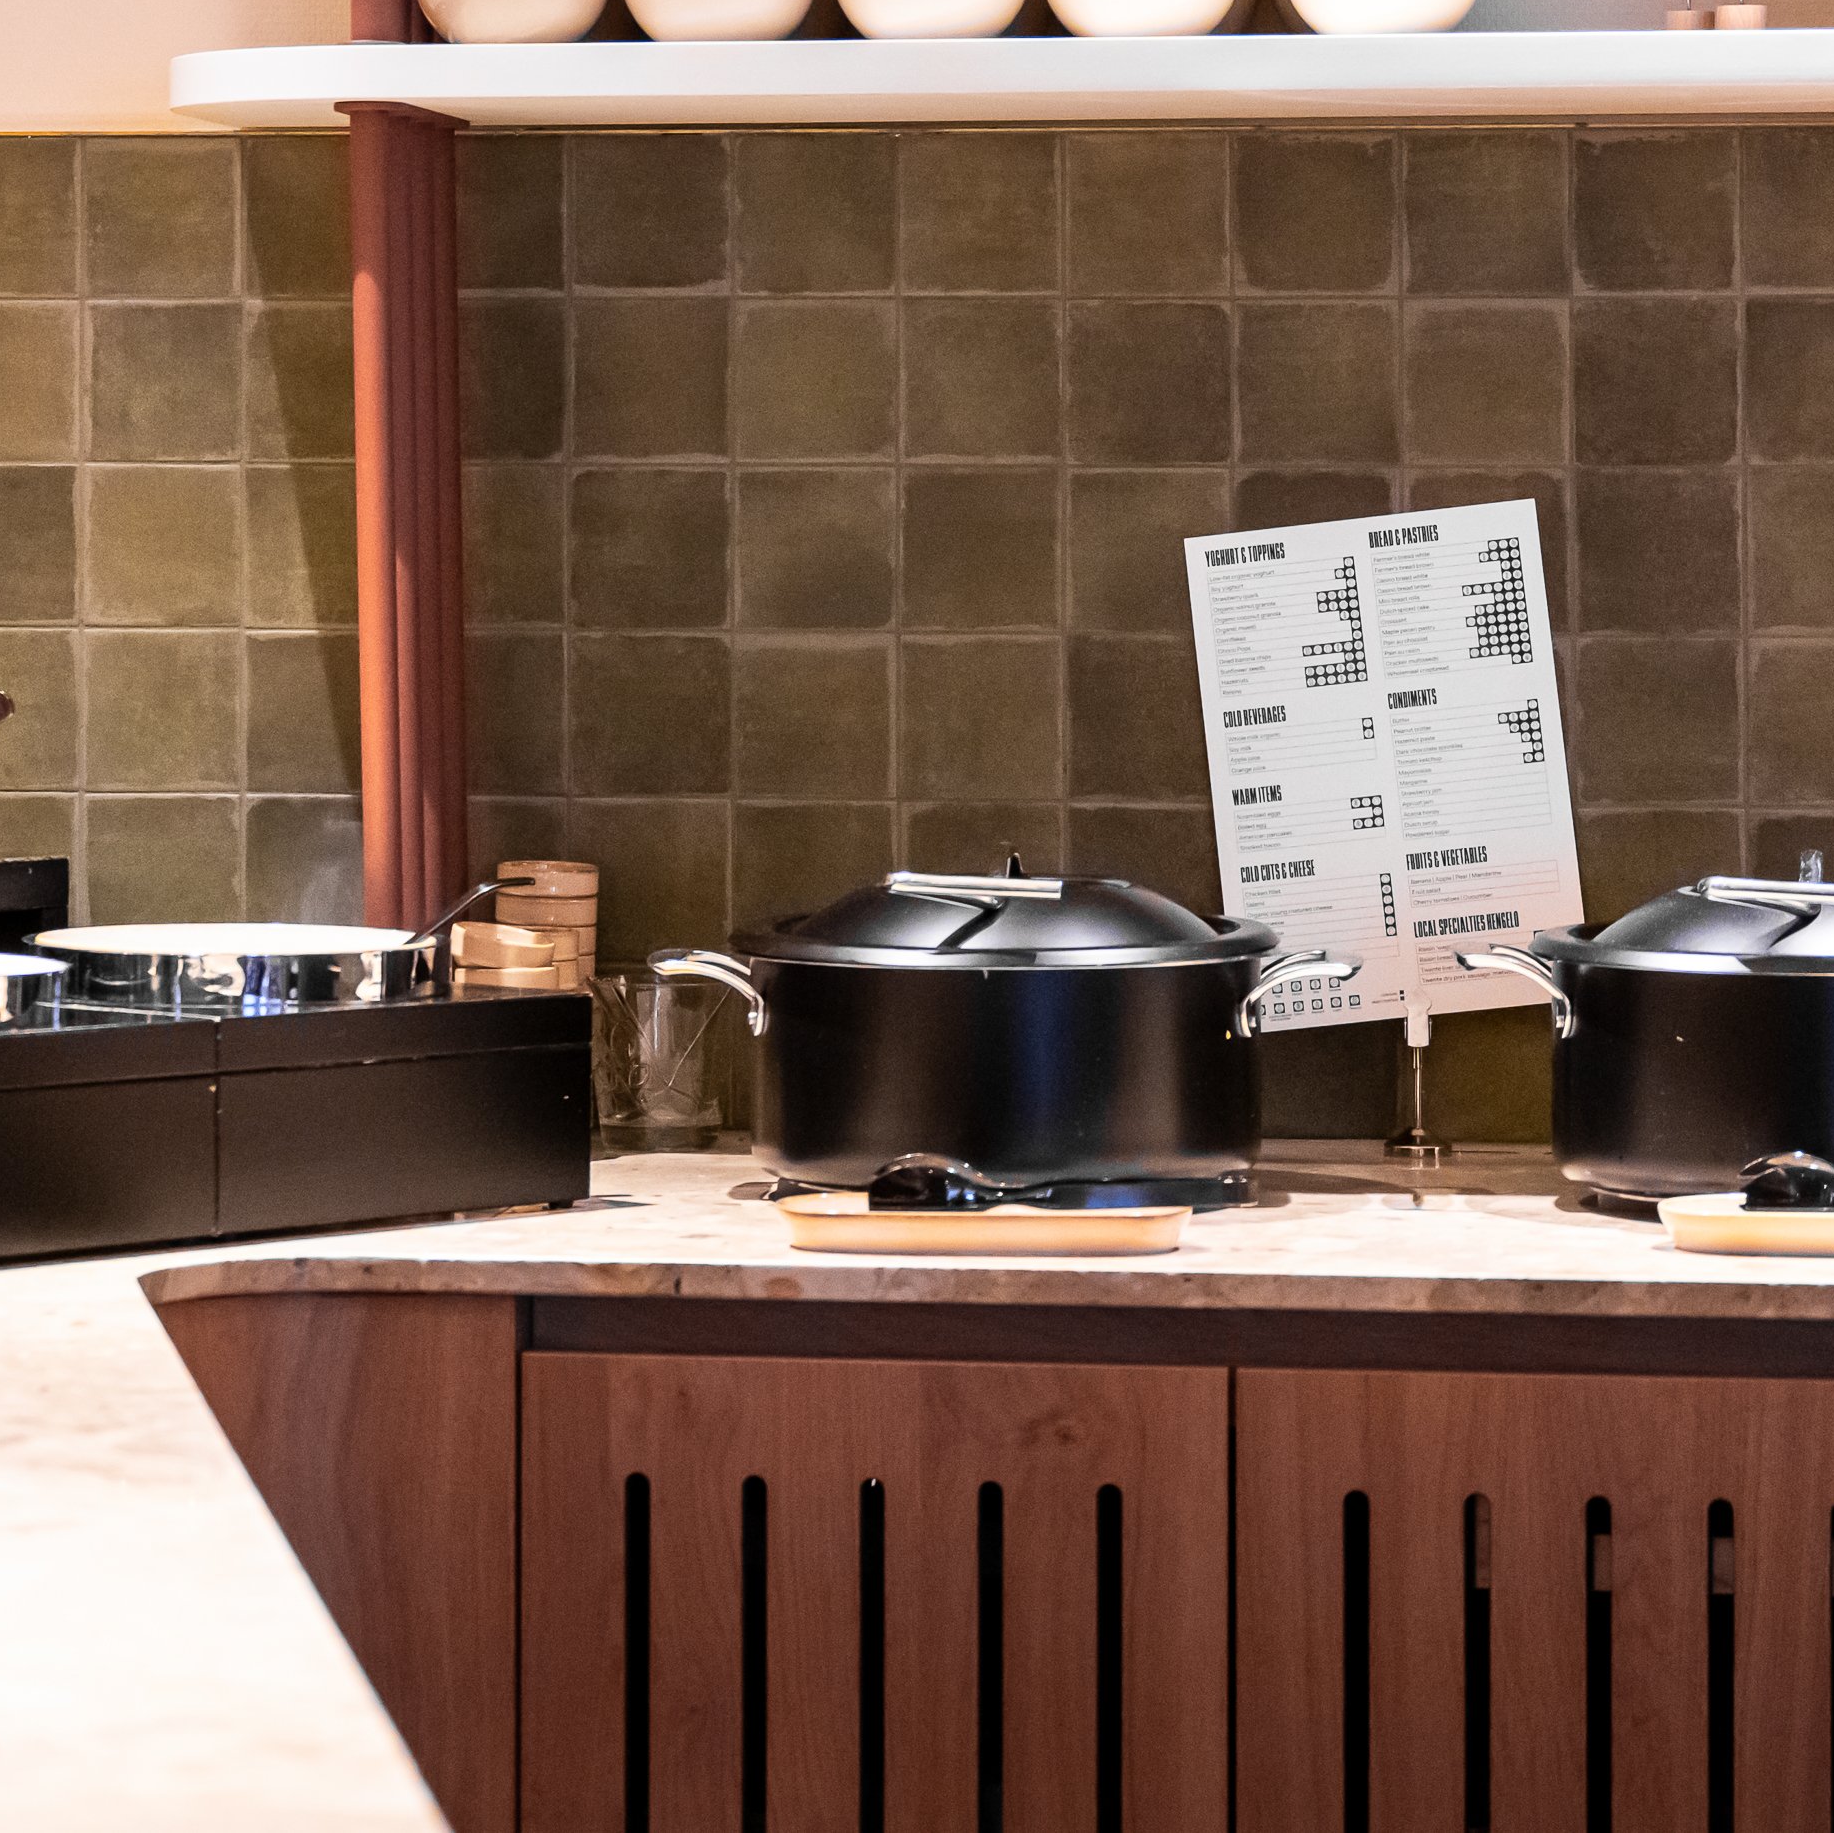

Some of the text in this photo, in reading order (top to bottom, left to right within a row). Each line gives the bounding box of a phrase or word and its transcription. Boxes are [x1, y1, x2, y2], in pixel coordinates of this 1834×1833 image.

[1368, 529, 1393, 548] BREAD
[1401, 524, 1439, 544] PASTRIES
[1204, 547, 1239, 567] YOGHURT
[1248, 542, 1285, 562] TOPPINGS
[1387, 688, 1437, 709] CONDIMENTS
[1223, 705, 1286, 728] COLD BEVERAGES
[1232, 784, 1282, 805] WARM ITEMS
[1405, 851, 1432, 870] FRUITS
[1440, 845, 1487, 866] VEGETABLES
[1240, 865, 1259, 883] COLD
[1260, 863, 1280, 881] CUTS
[1288, 859, 1315, 878] CHEESE
[1413, 911, 1519, 938] LOCAL SPECIALTIES HENGELO
